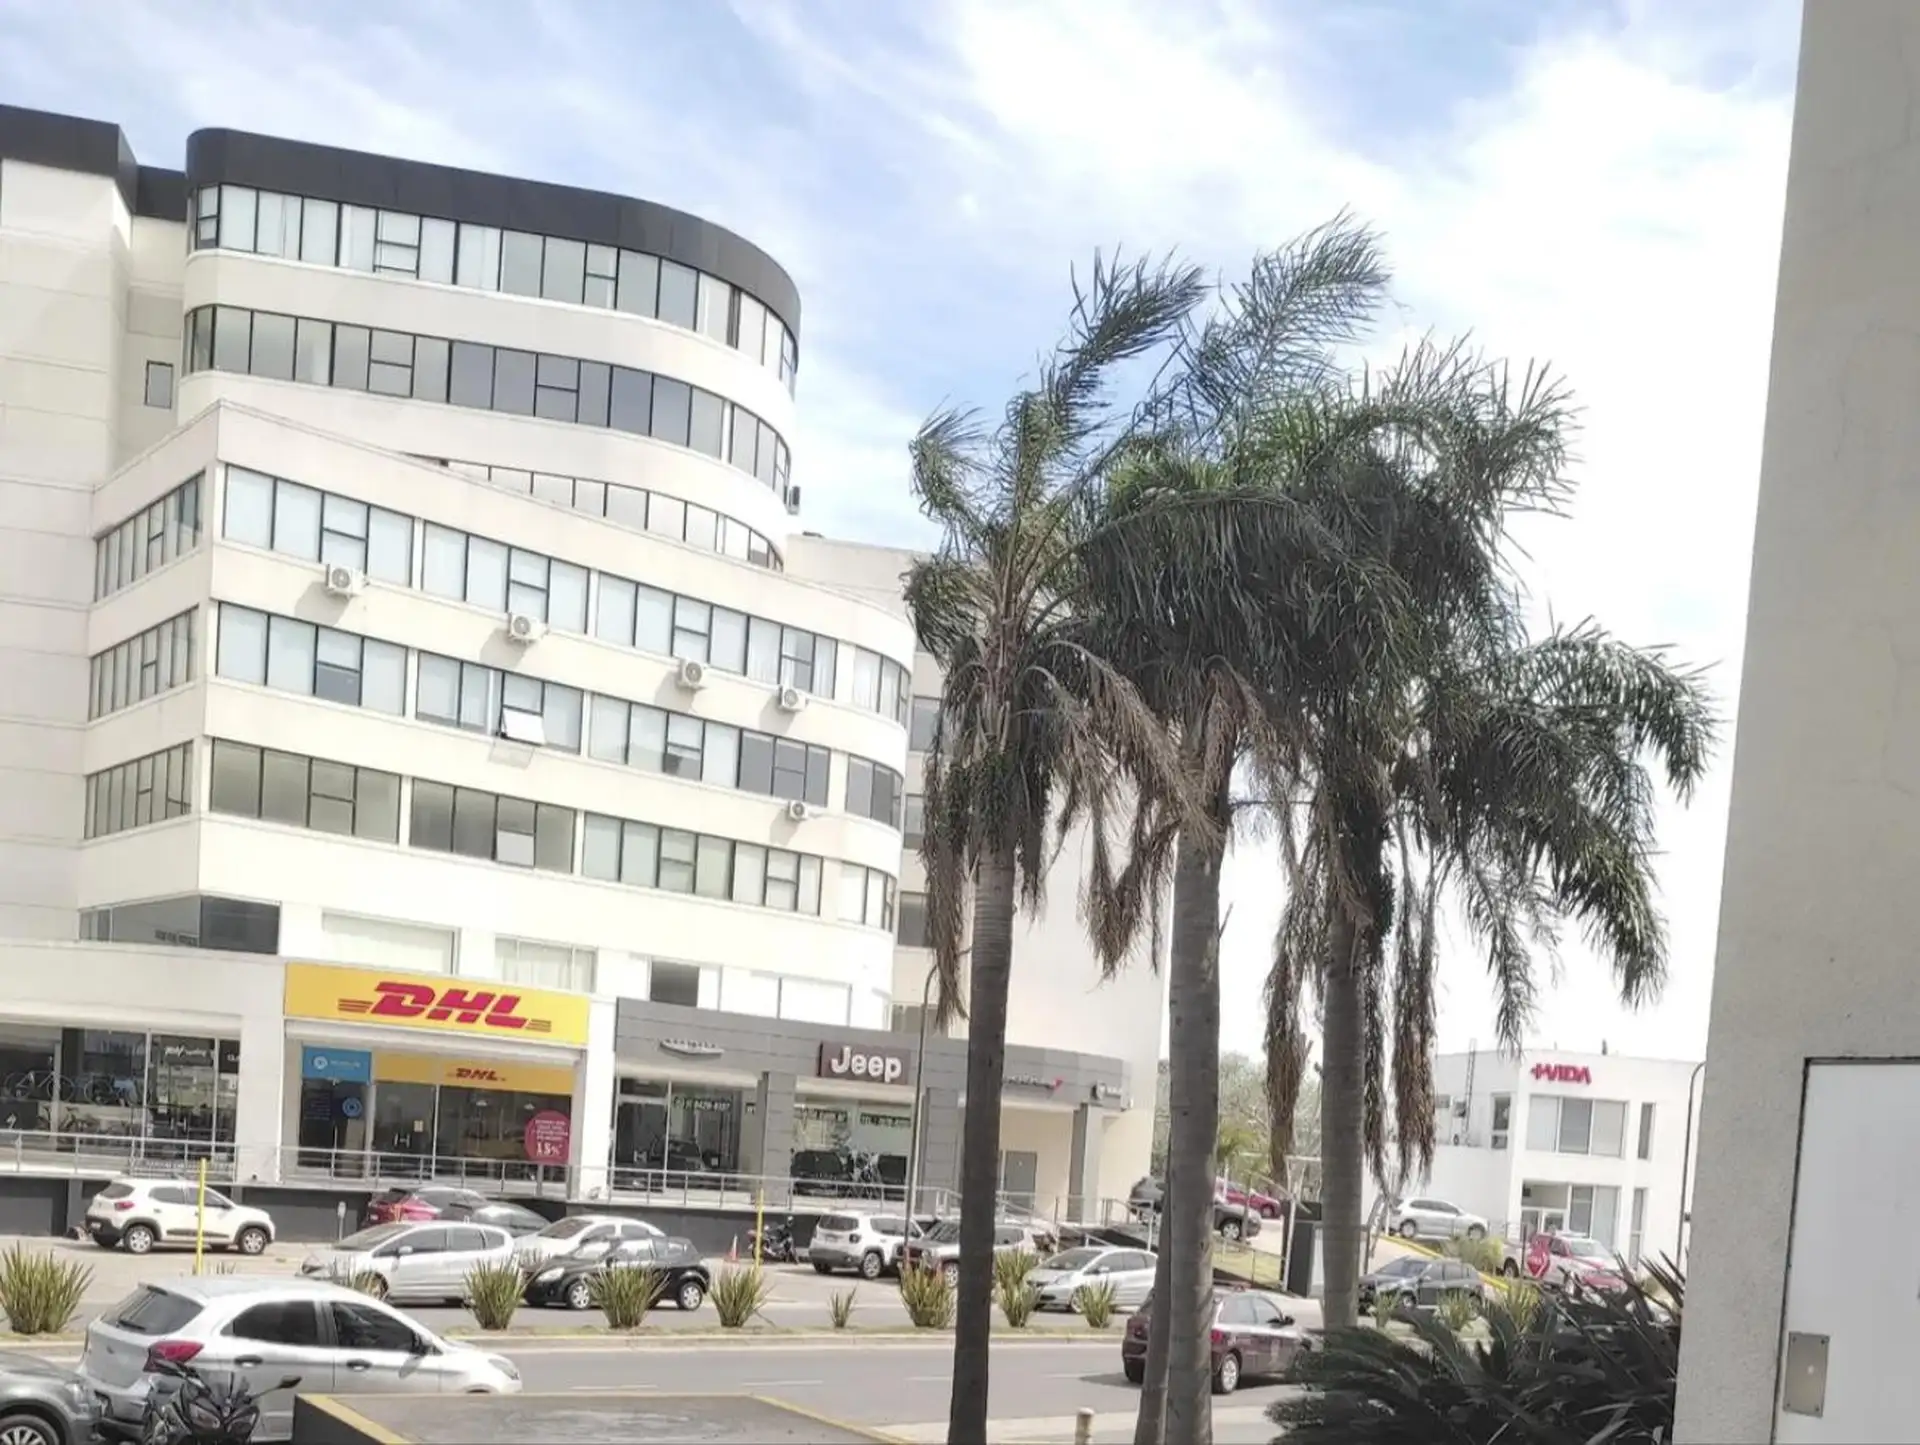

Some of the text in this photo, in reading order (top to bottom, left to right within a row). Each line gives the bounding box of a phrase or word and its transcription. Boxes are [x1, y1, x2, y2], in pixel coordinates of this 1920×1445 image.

[370, 981, 528, 1029] DHL
[456, 1067, 498, 1081] DHL
[831, 1045, 902, 1083] Jeep
